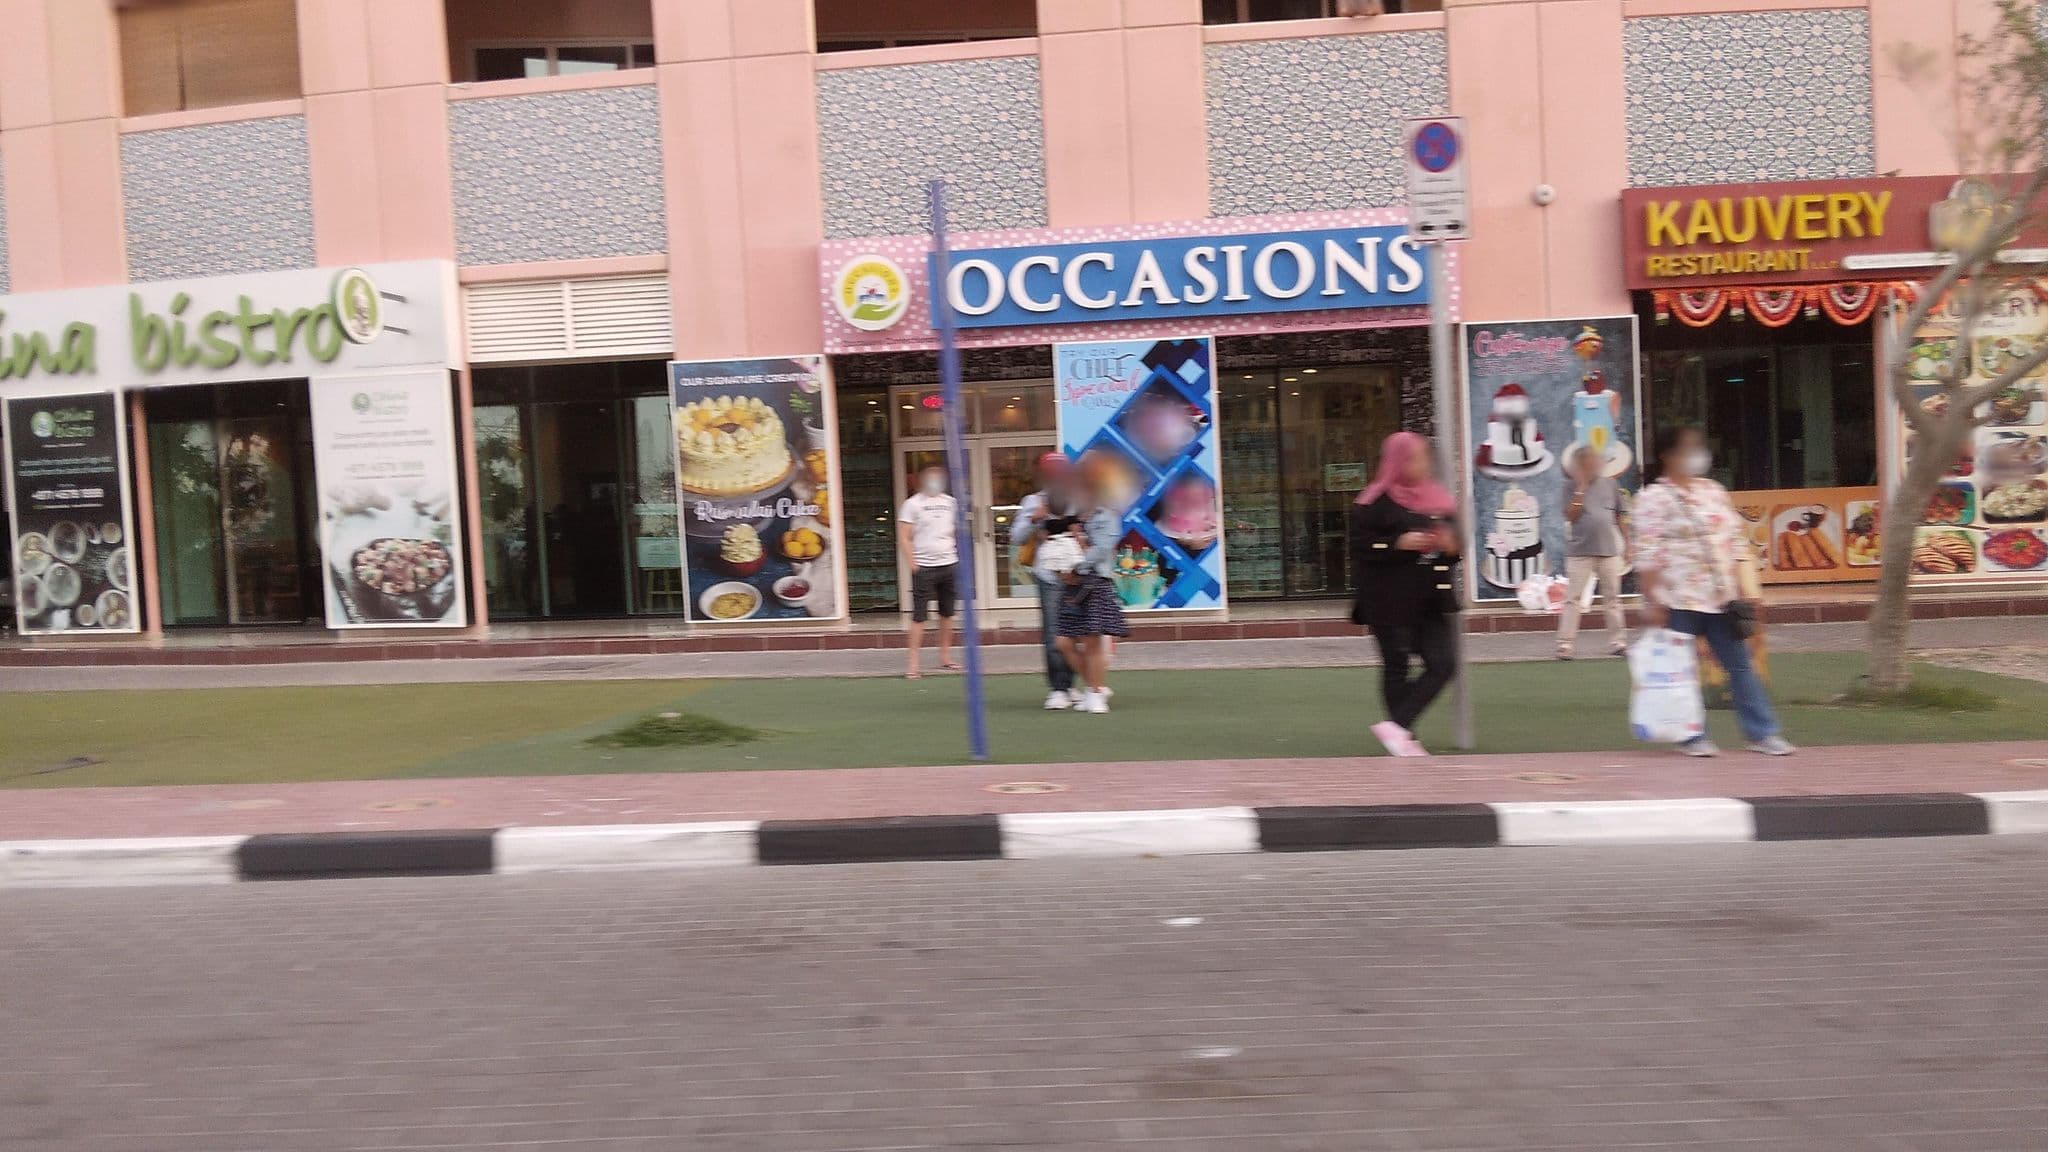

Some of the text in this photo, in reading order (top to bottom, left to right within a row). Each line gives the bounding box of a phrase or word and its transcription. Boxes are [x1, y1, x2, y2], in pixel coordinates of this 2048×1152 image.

[1647, 191, 1893, 247] KAUVERY
[947, 235, 1424, 317] OCCASIONS
[1647, 248, 1812, 278] RESTAURANT
[130, 292, 344, 372] bistro
[680, 376, 703, 386] OUR
[705, 374, 764, 385] SIGNATURE
